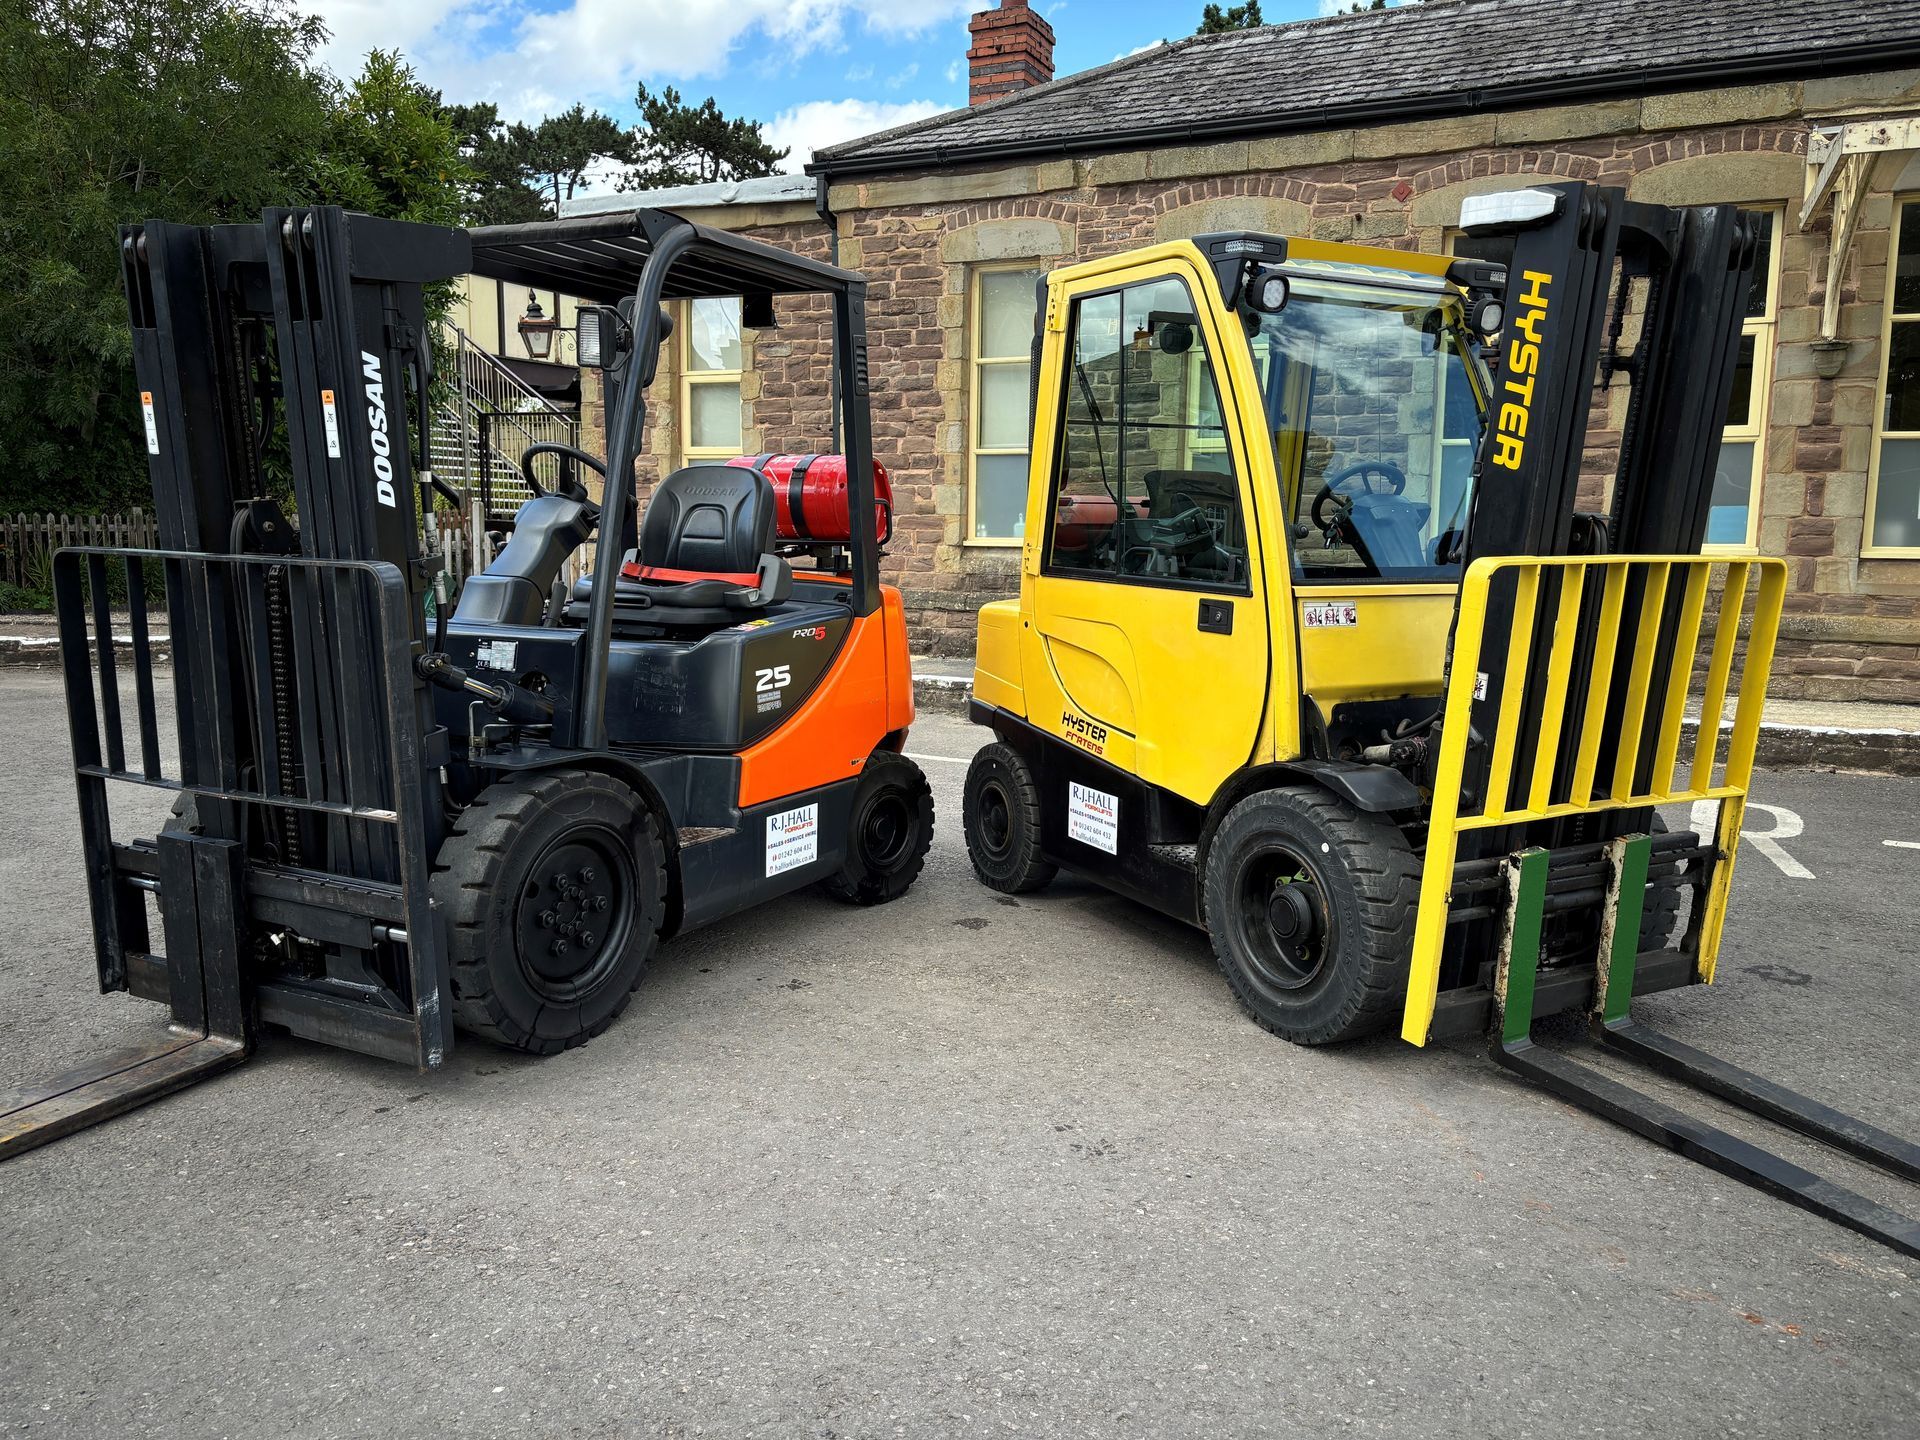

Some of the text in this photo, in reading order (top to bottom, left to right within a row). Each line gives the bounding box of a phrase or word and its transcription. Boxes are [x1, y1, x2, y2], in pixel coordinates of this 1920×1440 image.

[1493, 270, 1552, 471] HYSTER
[361, 350, 396, 508] DOOSAN
[755, 664, 791, 692] 25
[1062, 711, 1106, 743] HYSTER
[1073, 786, 1112, 811] R.J.HALL
[1084, 803, 1112, 817] FORKLIFTS
[771, 808, 813, 831] R.J.HALL
[784, 821, 813, 834] FORKLIFTS
